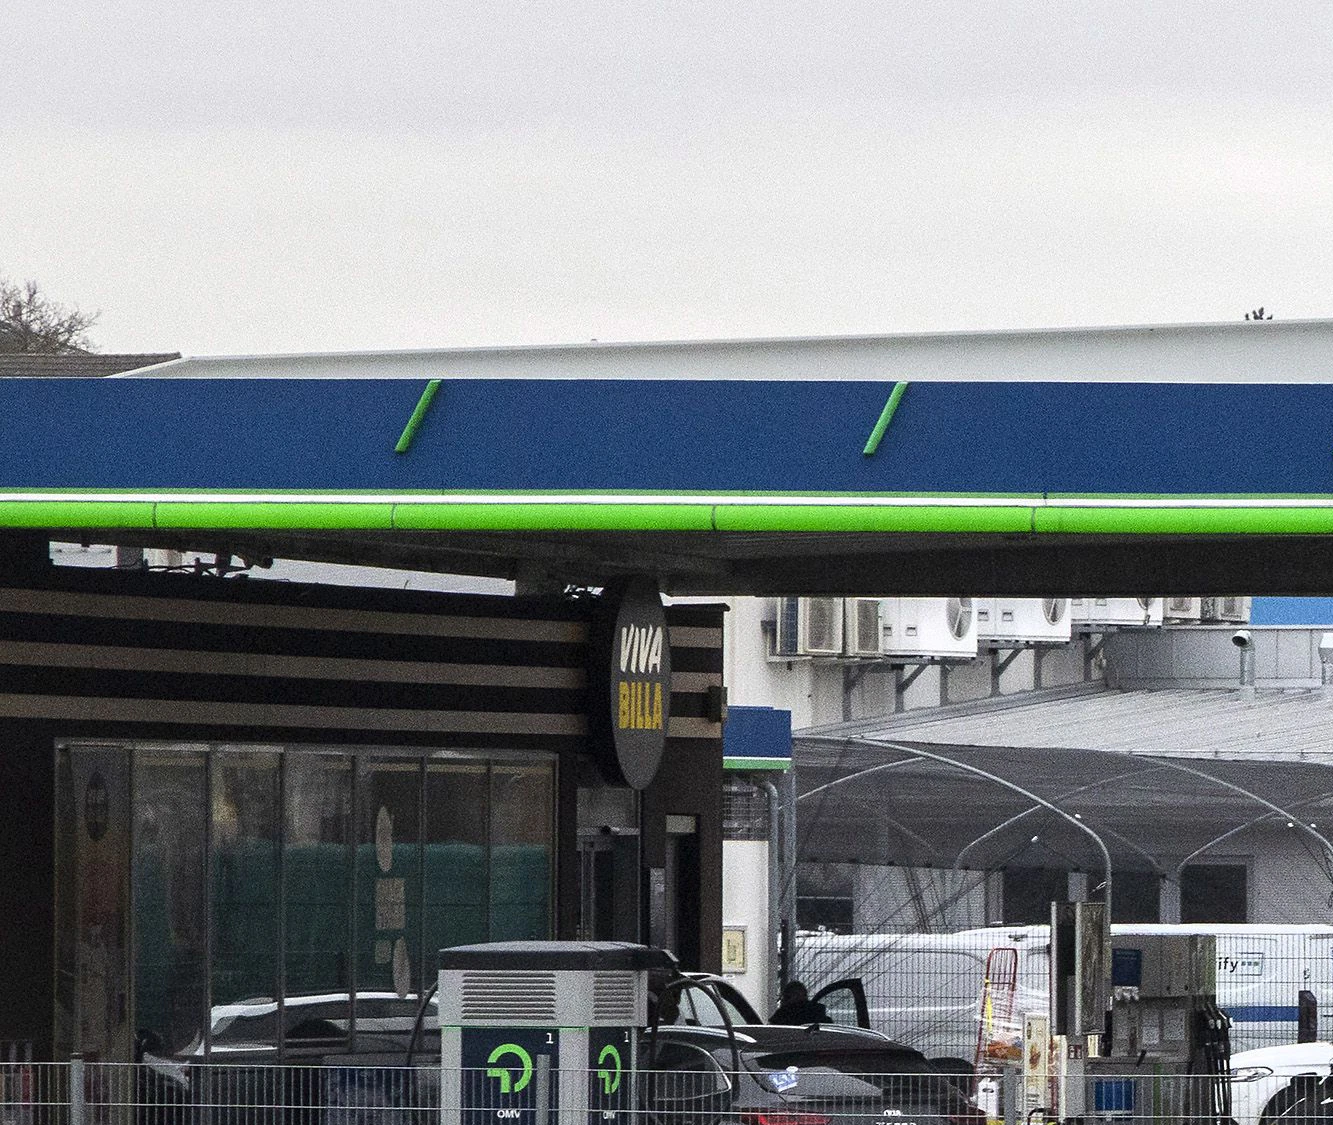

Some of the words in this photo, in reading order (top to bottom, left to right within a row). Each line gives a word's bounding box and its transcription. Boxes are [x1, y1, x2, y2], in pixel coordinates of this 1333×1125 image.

[620, 623, 663, 674] VIVA
[618, 681, 663, 730] BILLA
[1218, 957, 1239, 973] ify
[545, 1032, 554, 1044] 1
[624, 1031, 629, 1043] 1
[497, 1109, 521, 1119] OMV
